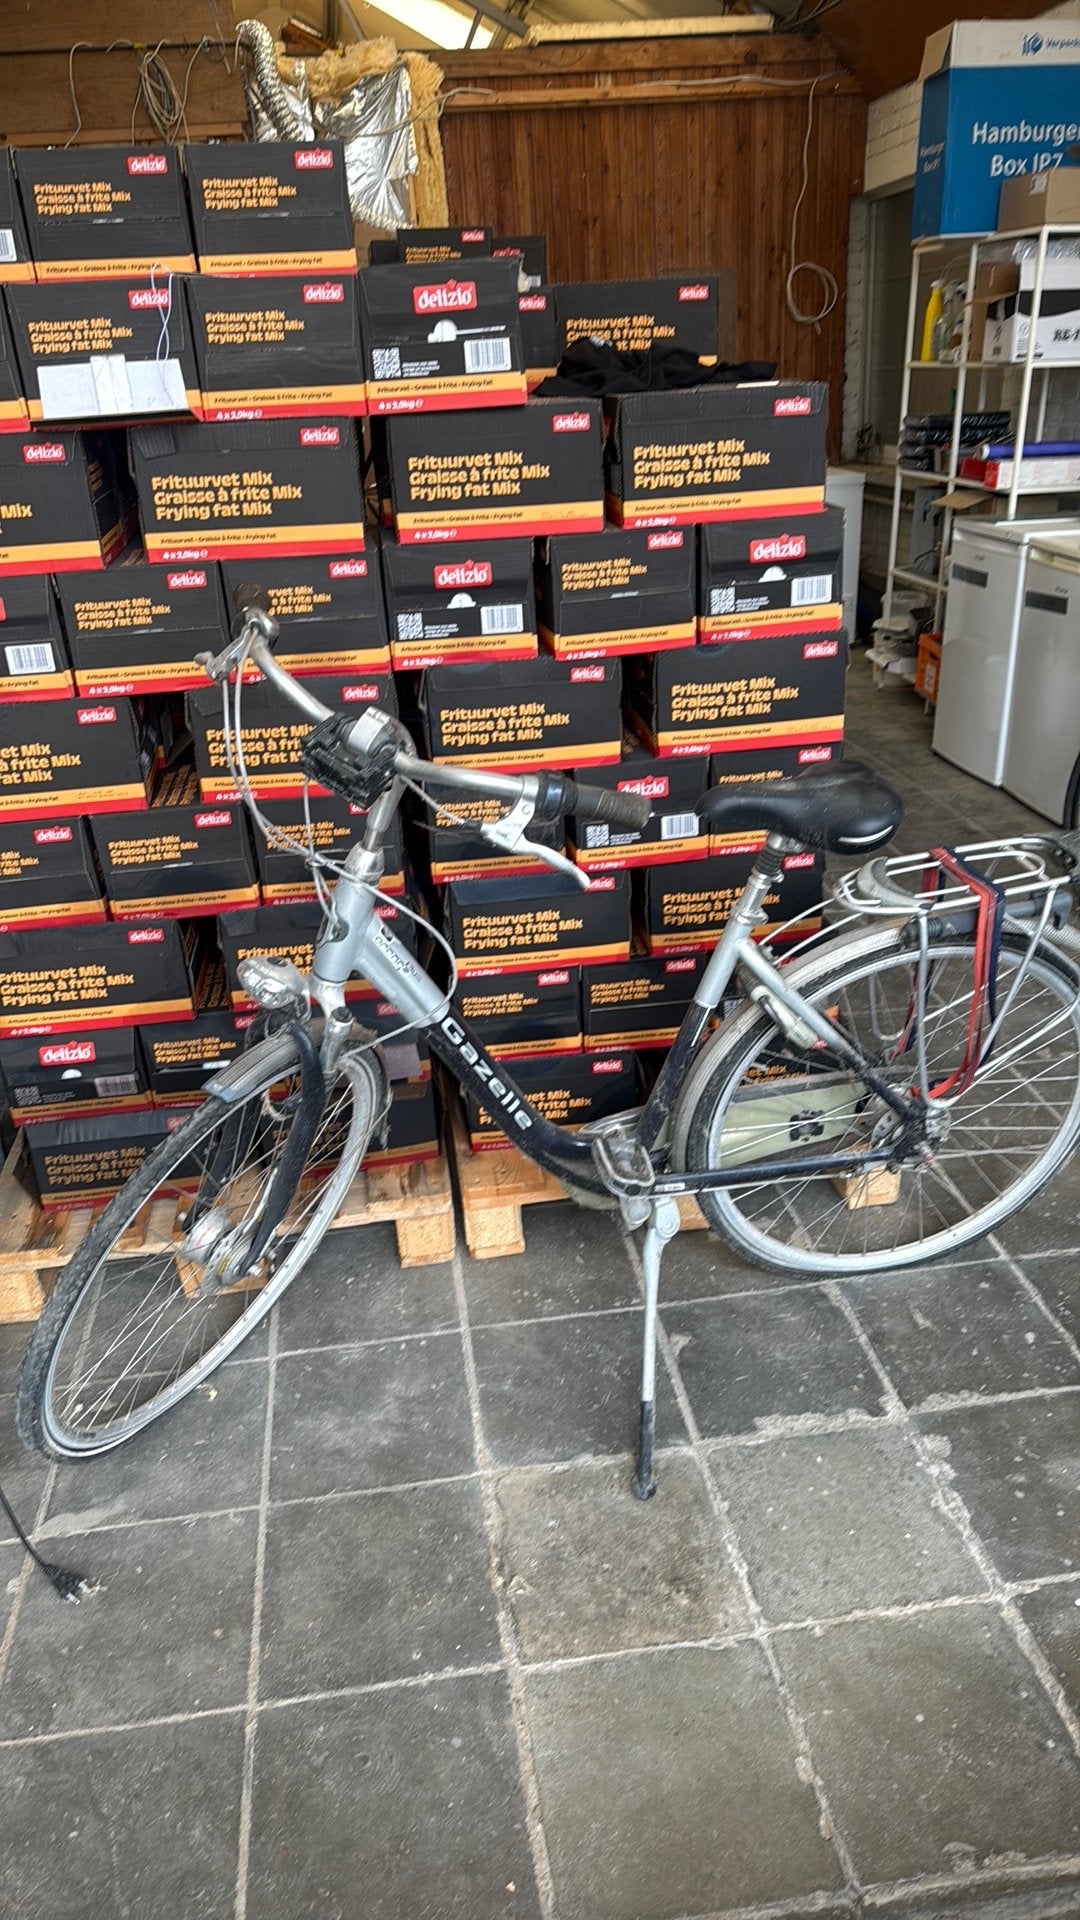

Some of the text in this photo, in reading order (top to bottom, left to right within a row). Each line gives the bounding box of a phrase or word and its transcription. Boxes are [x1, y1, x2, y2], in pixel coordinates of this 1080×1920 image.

[130, 158, 166, 172] delizio
[297, 152, 332, 167] delizio
[990, 154, 1028, 177] Box
[34, 181, 112, 194] Frituurvet Mix
[203, 176, 279, 188] Frituurvet Mix
[36, 193, 76, 204] Graisse
[85, 192, 110, 202] frite
[111, 191, 131, 201] Mix
[204, 188, 243, 198] Graisse
[252, 187, 276, 196] frite
[278, 186, 297, 196] Mix
[37, 202, 112, 215] Frying fat Mix
[205, 197, 278, 209] Frying fat Mix
[130, 290, 169, 307] delizio
[305, 286, 342, 301] delizio
[417, 286, 473, 309] delizio
[680, 287, 707, 299] delizio
[205, 310, 285, 322] Frituurvet Mix
[28, 317, 112, 332] Frituurvet Mix
[207, 322, 247, 332] Graisse
[257, 321, 283, 331] frite
[285, 320, 304, 330] Mix
[30, 331, 73, 342] Graisse
[83, 329, 110, 339] frite
[111, 327, 133, 337] Mix
[208, 331, 284, 344] Frying fat Mix
[32, 339, 112, 353] Frying fat Mix
[775, 399, 810, 413] delizio
[555, 415, 589, 430] delizio
[302, 429, 338, 443] delizio
[26, 445, 63, 460] delizio
[634, 438, 745, 460] Frituurvet Mix
[408, 450, 523, 471] Frituurvet Mix
[635, 451, 770, 474] Graisse à frite Mix
[152, 470, 273, 490] Frituurvet Mix
[410, 464, 550, 485] Graisse à frite Mix
[635, 468, 741, 489] Frying fat Mix
[154, 484, 303, 505] Graisse à frite Mix
[411, 481, 520, 501] Frying fat Mix
[1, 503, 32, 519] Mix
[156, 501, 272, 521] Frying fat Mix
[649, 532, 682, 547] delizio
[753, 537, 804, 560] delizio
[332, 562, 366, 576] delizio
[437, 565, 489, 587] delizio
[170, 573, 205, 587] delizio
[75, 597, 152, 611] Frituurvet Mix
[77, 610, 116, 620] Graisse
[125, 607, 150, 616] frite
[151, 605, 171, 614] Mix
[78, 616, 152, 629] Frying fat Mix
[805, 643, 837, 657] delizio
[572, 667, 604, 680] delizio
[344, 687, 377, 699] delizio
[672, 676, 776, 697] Frituurvet Mix
[672, 687, 799, 709] Graisse à frite Mix
[79, 709, 114, 723] delizio
[441, 702, 545, 721] Frituurvet Mix
[672, 702, 771, 722] Frying fat Mix
[442, 713, 570, 734] Graisse à frite Mix
[443, 728, 543, 746] Frying fat Mix
[21, 743, 51, 757] Mix
[799, 748, 832, 762] delizio
[10, 753, 81, 770] frite Mix
[23, 769, 53, 783] Mix
[197, 813, 230, 826] delizio
[36, 828, 70, 842] delizio
[463, 910, 560, 928] Frituurvet Mix
[129, 930, 162, 942] delizio
[464, 919, 583, 939] Graisse à frite Mix
[464, 932, 557, 949] Frying fat Mix
[0, 964, 107, 984] Frituurvet Mix
[0, 973, 134, 995] Graisse à frite Mix
[2, 987, 108, 1006] Frying fat Mix
[43, 1044, 92, 1063] delizio
[441, 1016, 533, 1131] Gazelle
[593, 1061, 621, 1071] delizio
